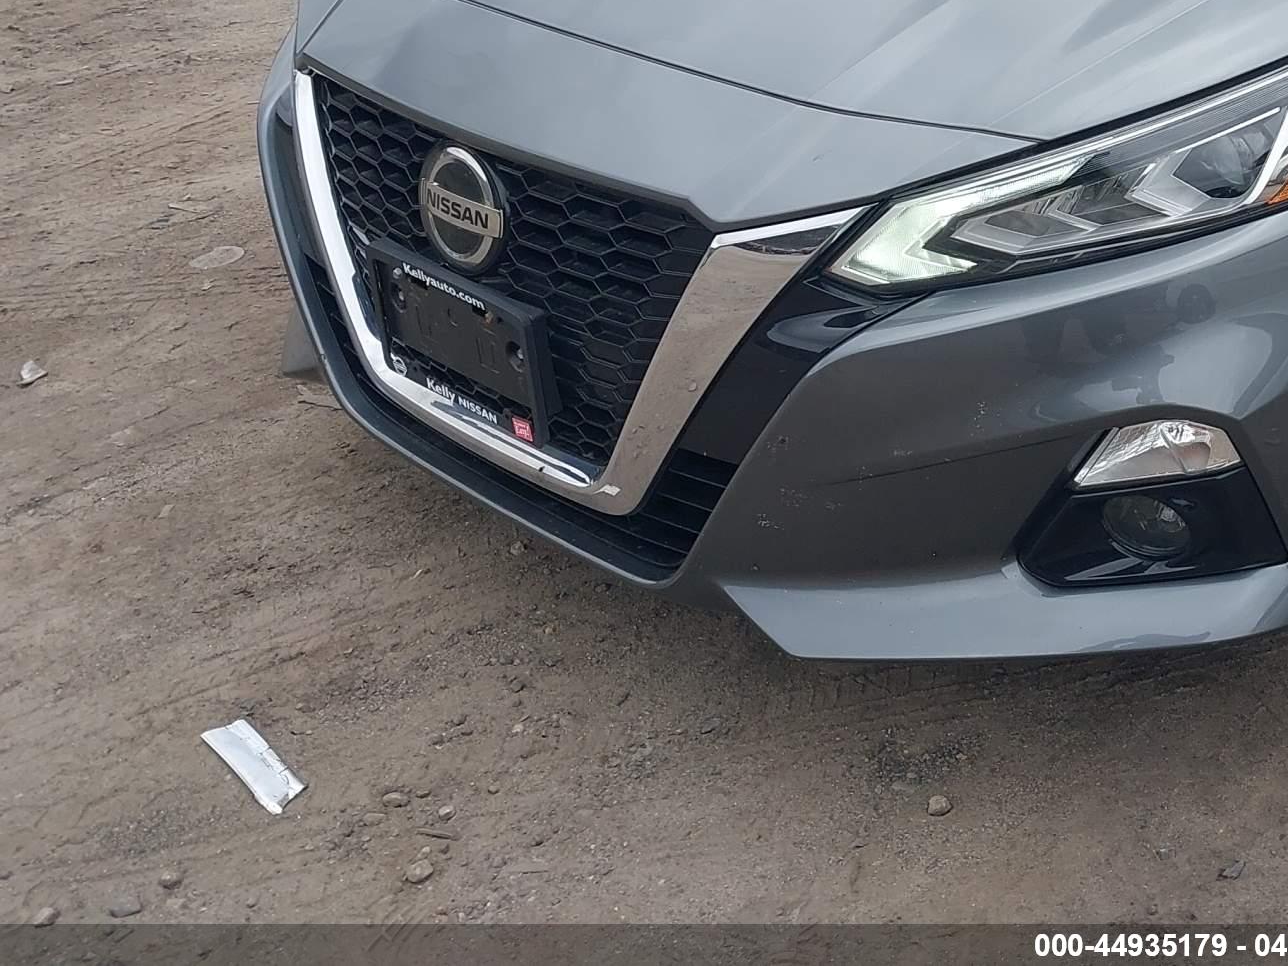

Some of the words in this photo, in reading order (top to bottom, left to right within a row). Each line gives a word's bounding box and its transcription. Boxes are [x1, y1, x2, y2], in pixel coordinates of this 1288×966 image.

[426, 188, 489, 229] NISSAN
[402, 262, 486, 311] Kellyauto.com
[426, 377, 456, 405] Kelly
[458, 397, 498, 425] NISSAN
